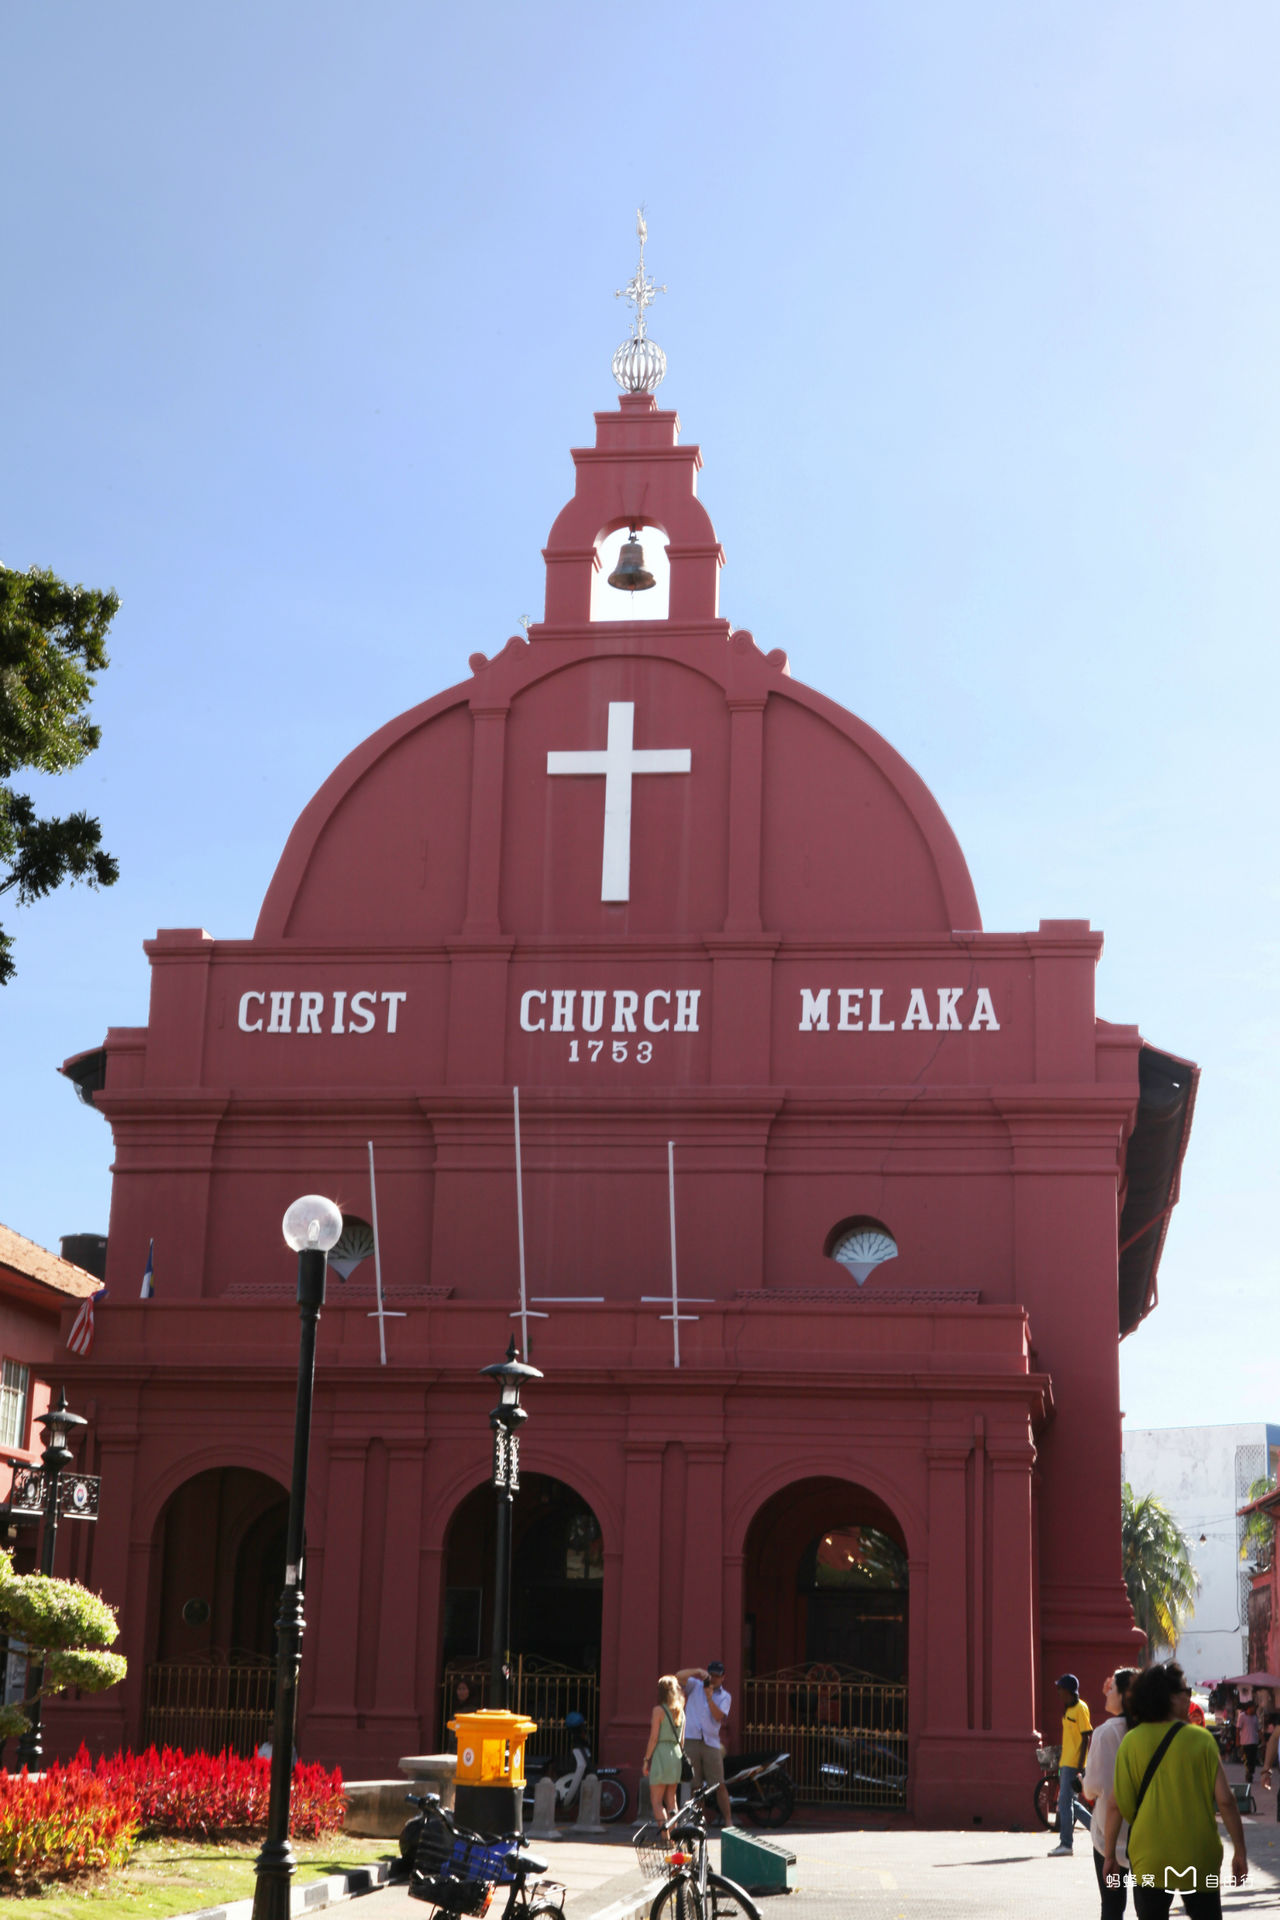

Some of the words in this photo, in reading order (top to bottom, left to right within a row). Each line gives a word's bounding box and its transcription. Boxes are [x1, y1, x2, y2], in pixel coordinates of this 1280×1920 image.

[238, 991, 407, 1034] CHRIST
[519, 989, 701, 1033] CHURCH
[798, 987, 1001, 1031] MELAKA
[568, 1040, 653, 1064] 1753
